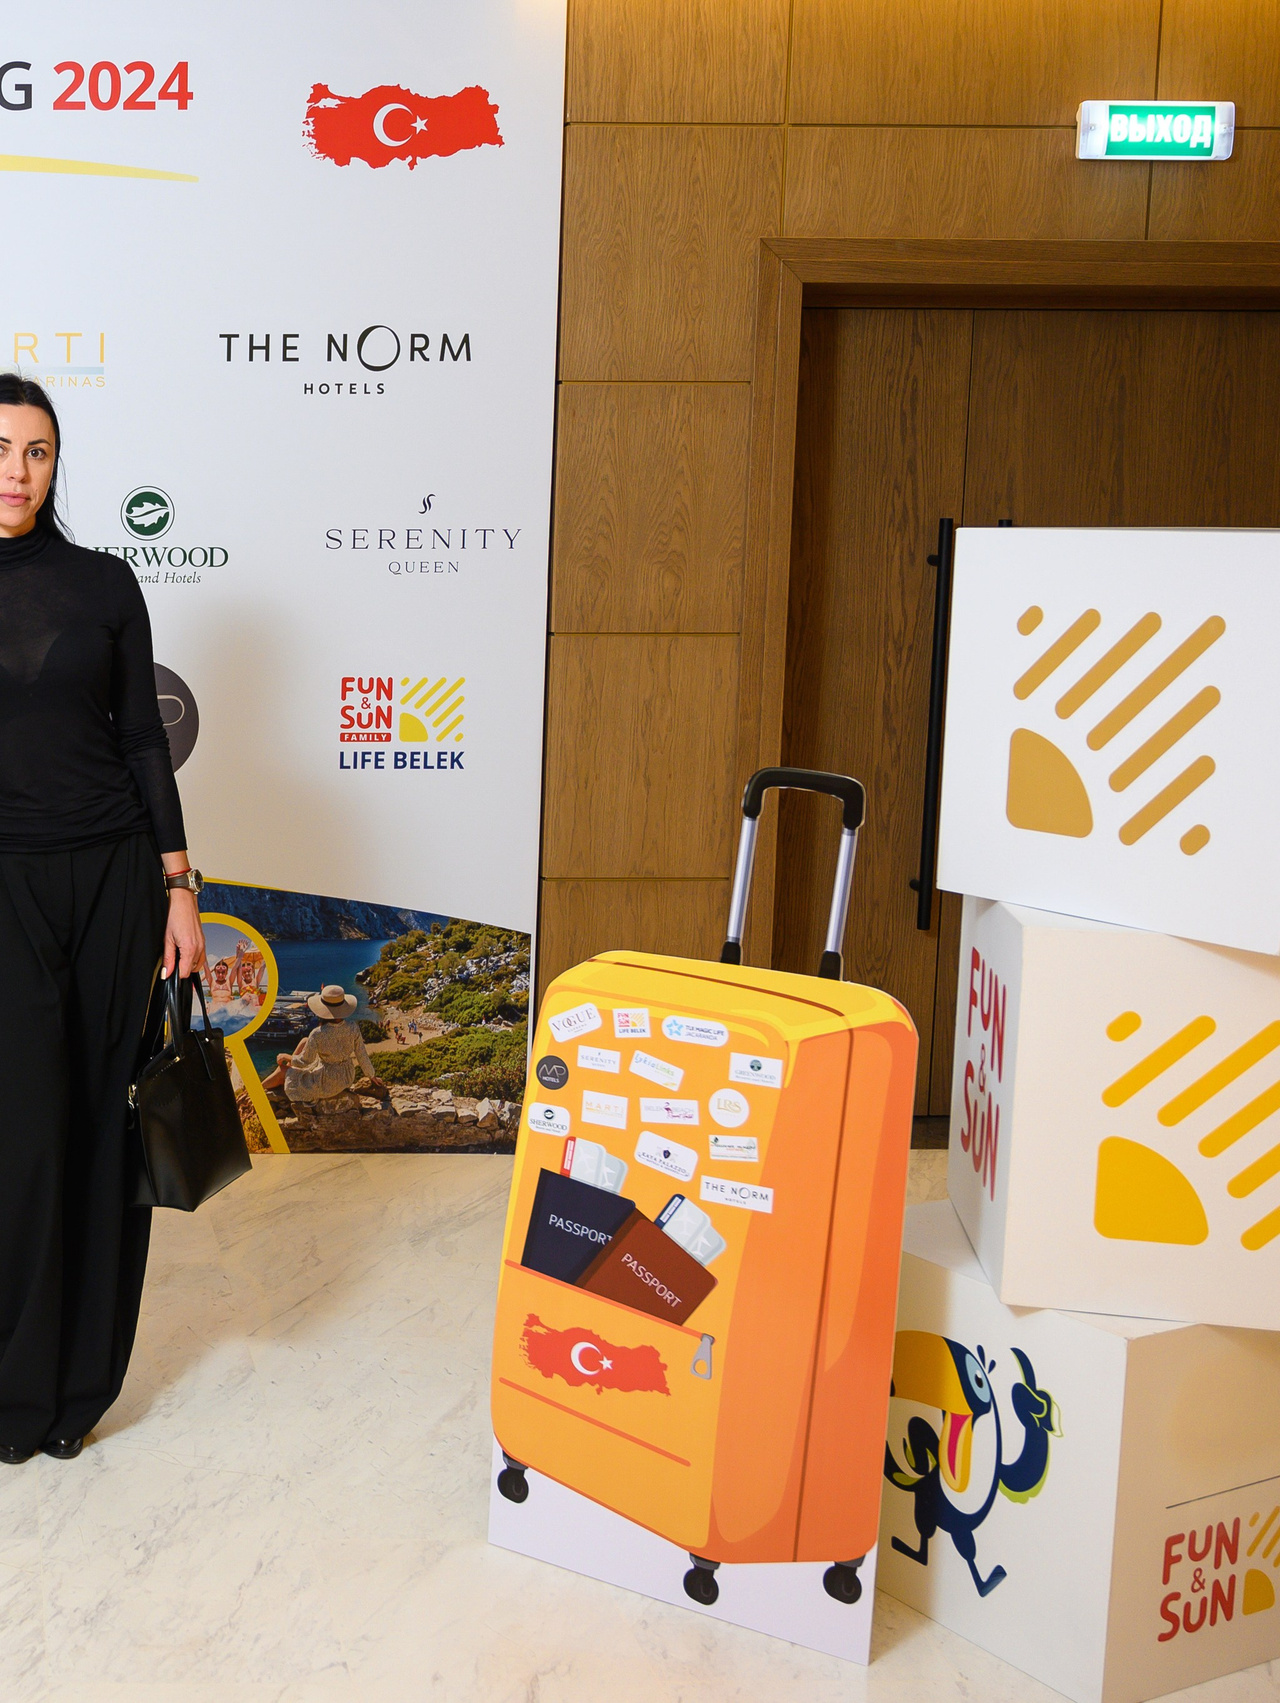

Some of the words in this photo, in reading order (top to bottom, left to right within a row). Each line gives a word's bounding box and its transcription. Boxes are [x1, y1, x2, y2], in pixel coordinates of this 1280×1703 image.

[52, 60, 194, 111] 2024
[1110, 113, 1212, 148] ВЫХОД
[219, 333, 299, 362] THE
[327, 324, 471, 372] NORM
[24, 376, 107, 388] ARINAS
[304, 383, 385, 395] HOTELS
[325, 528, 522, 550] SERENITY
[137, 572, 160, 584] and
[164, 572, 201, 584] Hotels
[388, 561, 459, 575] QUEEN
[341, 677, 393, 701] FUN
[360, 696, 371, 709] &
[340, 705, 392, 729] SUN
[344, 733, 387, 741] FAMILY
[339, 751, 385, 770] LIFE
[394, 751, 465, 770] BELEK
[552, 1008, 596, 1031] VOGUE
[967, 946, 1007, 1083] FUN
[960, 1060, 1000, 1202] SUN
[704, 1181, 726, 1193] THE
[731, 1187, 769, 1201] NORM
[620, 1252, 682, 1308] PASSPORT
[1162, 1516, 1240, 1585] FUN
[1190, 1567, 1206, 1593] &
[1157, 1574, 1236, 1642] SUN
